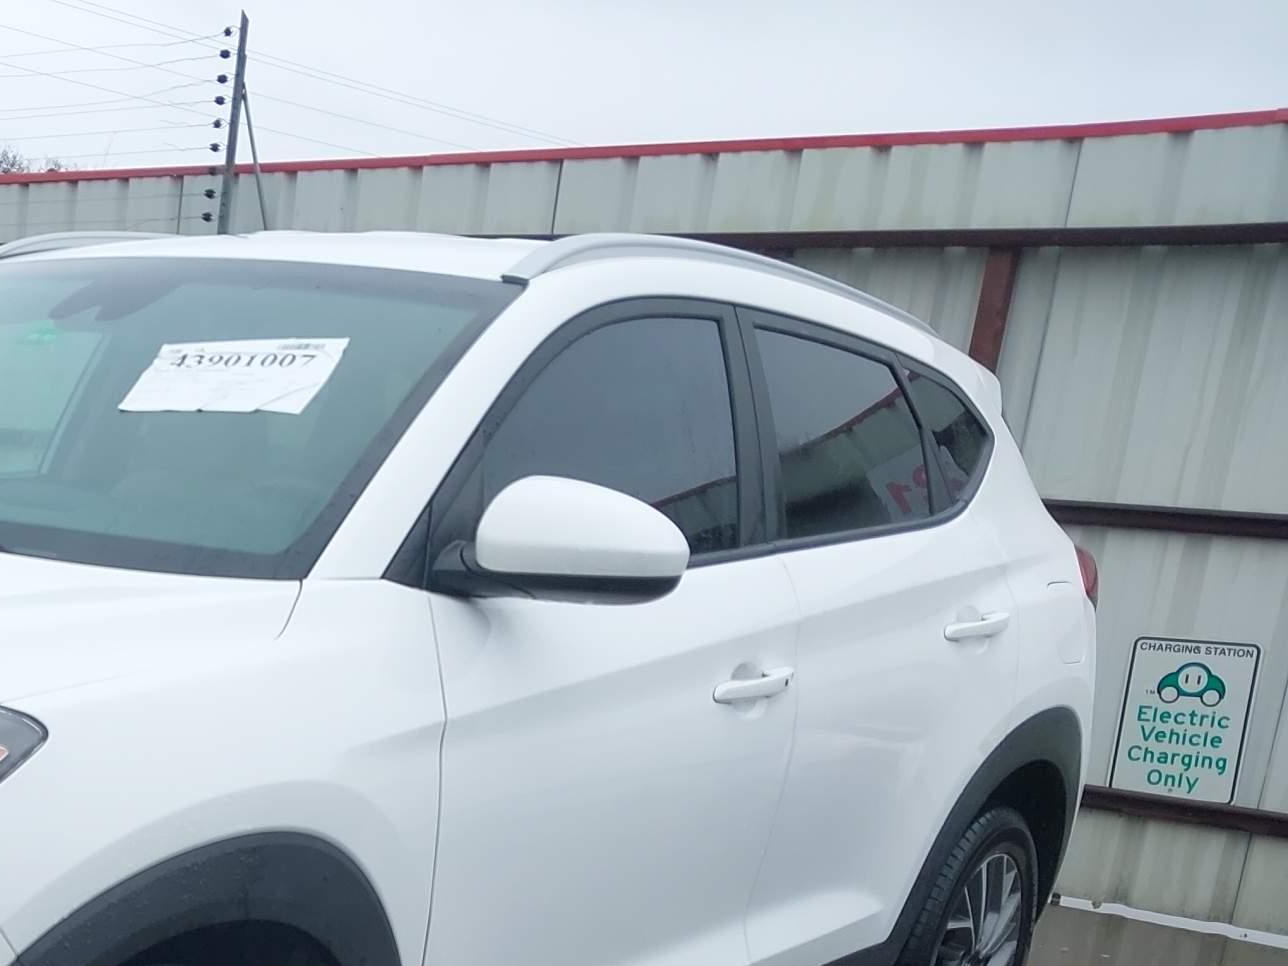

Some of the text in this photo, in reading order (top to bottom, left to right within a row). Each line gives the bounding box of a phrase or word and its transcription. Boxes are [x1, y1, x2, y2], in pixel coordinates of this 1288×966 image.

[169, 352, 317, 369] 43901007
[1140, 641, 1255, 658] CHARGING STATION
[1137, 705, 1231, 729] Electric
[1140, 725, 1223, 748] Vehicle
[1127, 745, 1227, 775] Charging
[1146, 769, 1199, 794] Only
